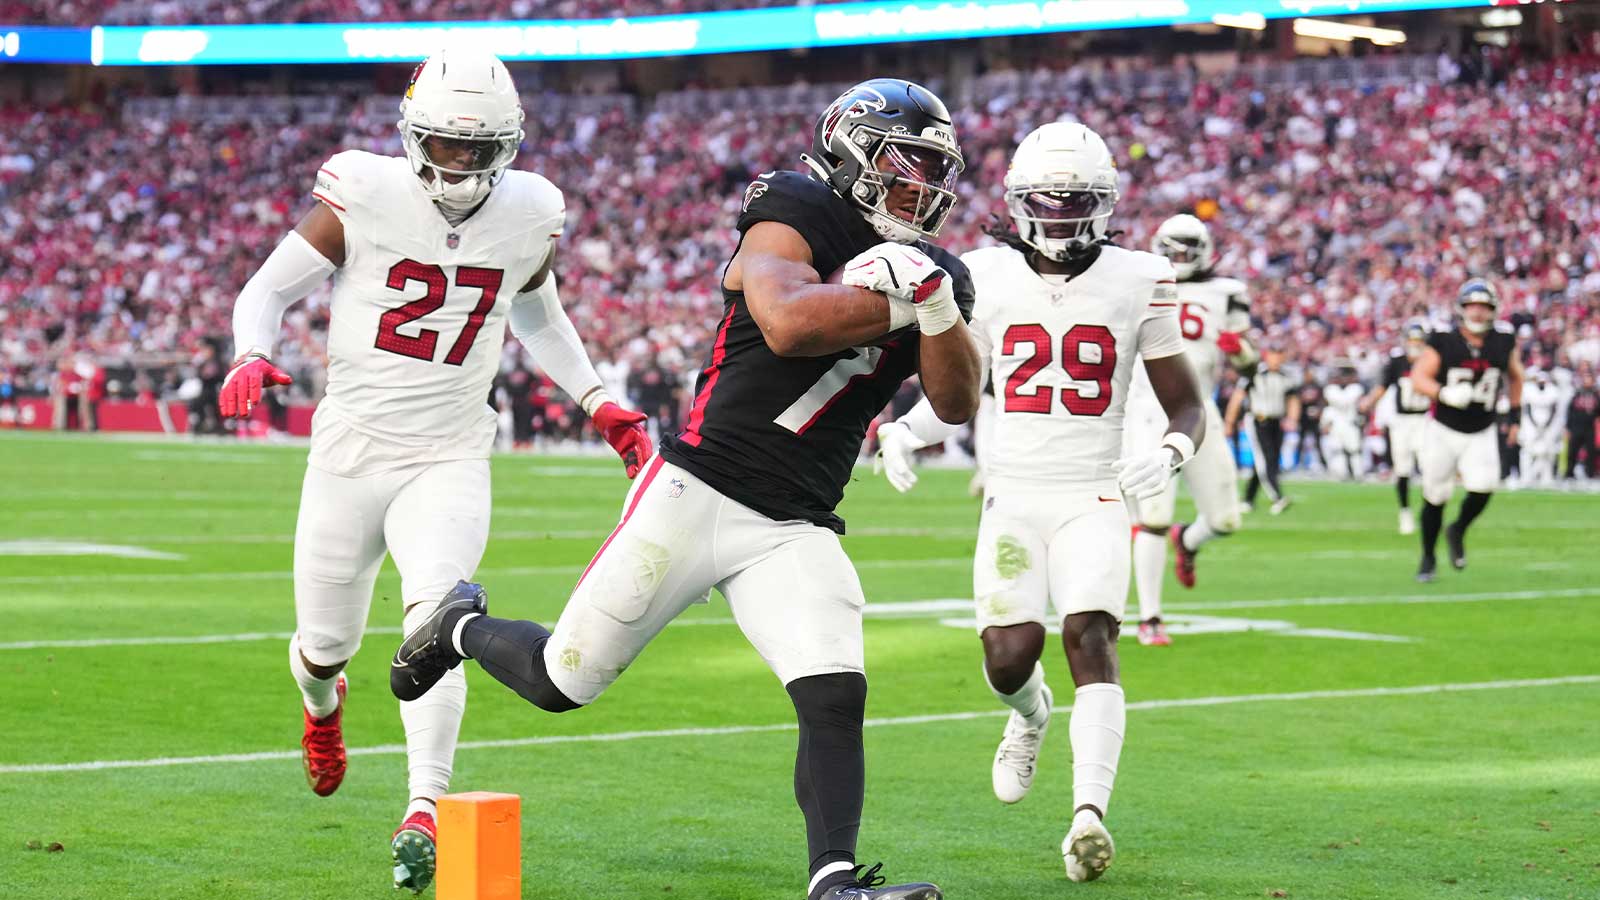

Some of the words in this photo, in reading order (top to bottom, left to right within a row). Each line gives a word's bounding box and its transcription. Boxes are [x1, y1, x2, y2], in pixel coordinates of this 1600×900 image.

[934, 129, 952, 142] ATL
[374, 258, 505, 366] 27
[772, 346, 888, 436] 7
[1001, 323, 1117, 416] 29
